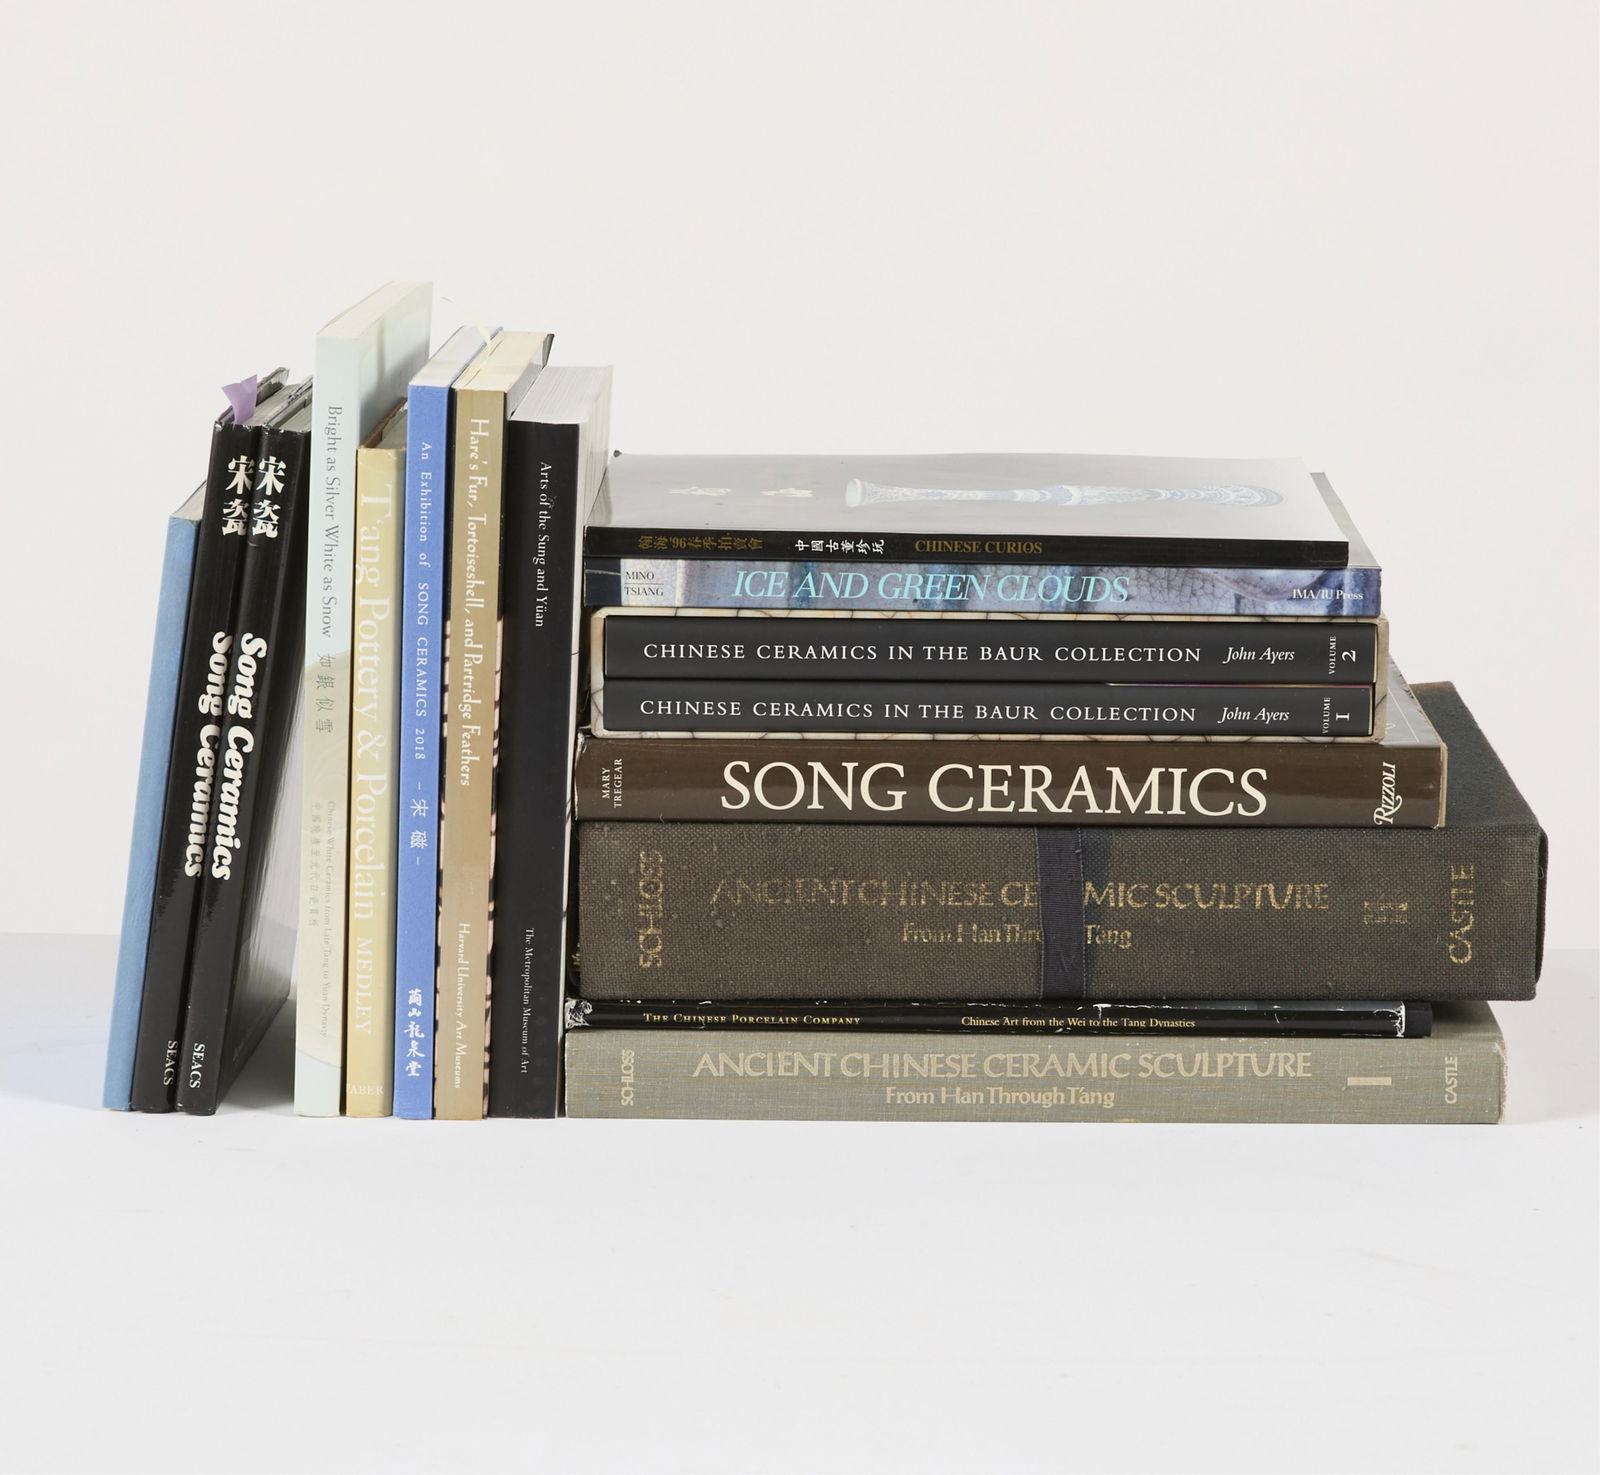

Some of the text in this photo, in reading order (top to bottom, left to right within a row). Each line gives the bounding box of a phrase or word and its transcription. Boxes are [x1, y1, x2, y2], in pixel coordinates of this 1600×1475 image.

[252, 455, 287, 538] 宋瓷
[321, 406, 343, 638] Bright as Silver White as Snow
[532, 461, 552, 627] Arts of the Sung and Yüan
[794, 539, 885, 556] 中國古董珍玩
[914, 539, 1043, 555] CHINESE CURIOS
[624, 586, 664, 597] TSIANG
[625, 570, 655, 580] MINO
[731, 570, 1130, 603] ICE AND GREEN CLOUDS
[414, 441, 433, 760] An Exhibition of SONG CERAMICS 2018
[458, 418, 490, 787] Hare's Fur, Tortoiseshell, and Partridge Feathers
[1292, 588, 1364, 601] IMA/IU Press
[353, 596, 391, 721] Pottery
[643, 644, 1201, 664] CHINESE CERAMICS IN THE BAUR COLLECTION
[1222, 647, 1295, 665] John Ayers
[1328, 635, 1337, 675] VOLUME
[1342, 649, 1357, 662] 2
[314, 652, 337, 733] 如銀似雪
[640, 700, 1197, 723] CHINESE CERAMICS IN THE BAUR COLLECTION
[1217, 706, 1290, 724] John Ayers
[1322, 696, 1331, 734] VOLUME
[211, 632, 268, 880] Song Ceramics
[356, 730, 387, 761] &
[601, 767, 611, 799] MARY
[613, 758, 623, 808] TREGEAR
[720, 759, 1269, 817] SONG CERAMICS
[1373, 762, 1403, 826] RIZZOLI
[326, 800, 336, 834] Chinese
[325, 837, 336, 863] White
[354, 771, 388, 920] Porcelain
[324, 865, 335, 903] Ceramics
[709, 879, 854, 906] ANCIENT
[858, 879, 994, 907] CHINESE
[1154, 882, 1330, 910] SCULPTURE
[324, 906, 333, 925] from
[639, 850, 665, 968] SCHLOSS
[1448, 864, 1475, 965] CASTLE
[902, 922, 950, 943] From
[957, 922, 1000, 943] Han
[354, 937, 374, 1035] MEDLEY
[520, 927, 535, 1073] The Metropolitan Museum of Art
[454, 923, 471, 1089] Harvard University Art Museums
[643, 1012, 861, 1026] THE CHINESE PORCELAIN COMPANY
[961, 1016, 1196, 1030] Chinese Art from the Wei to the Tang Dynasties
[163, 1040, 178, 1087] SEACS
[189, 1042, 206, 1089] SEACS
[621, 1049, 635, 1106] SCHLOSS
[691, 1051, 1313, 1079] ANCIENT CHINESE CERAMIC SCULPTURE
[1445, 1055, 1458, 1104] CASTLE
[347, 1084, 385, 1096] ABER
[885, 1086, 935, 1105] From
[940, 1086, 984, 1105] Han
[986, 1086, 1066, 1109] Through
